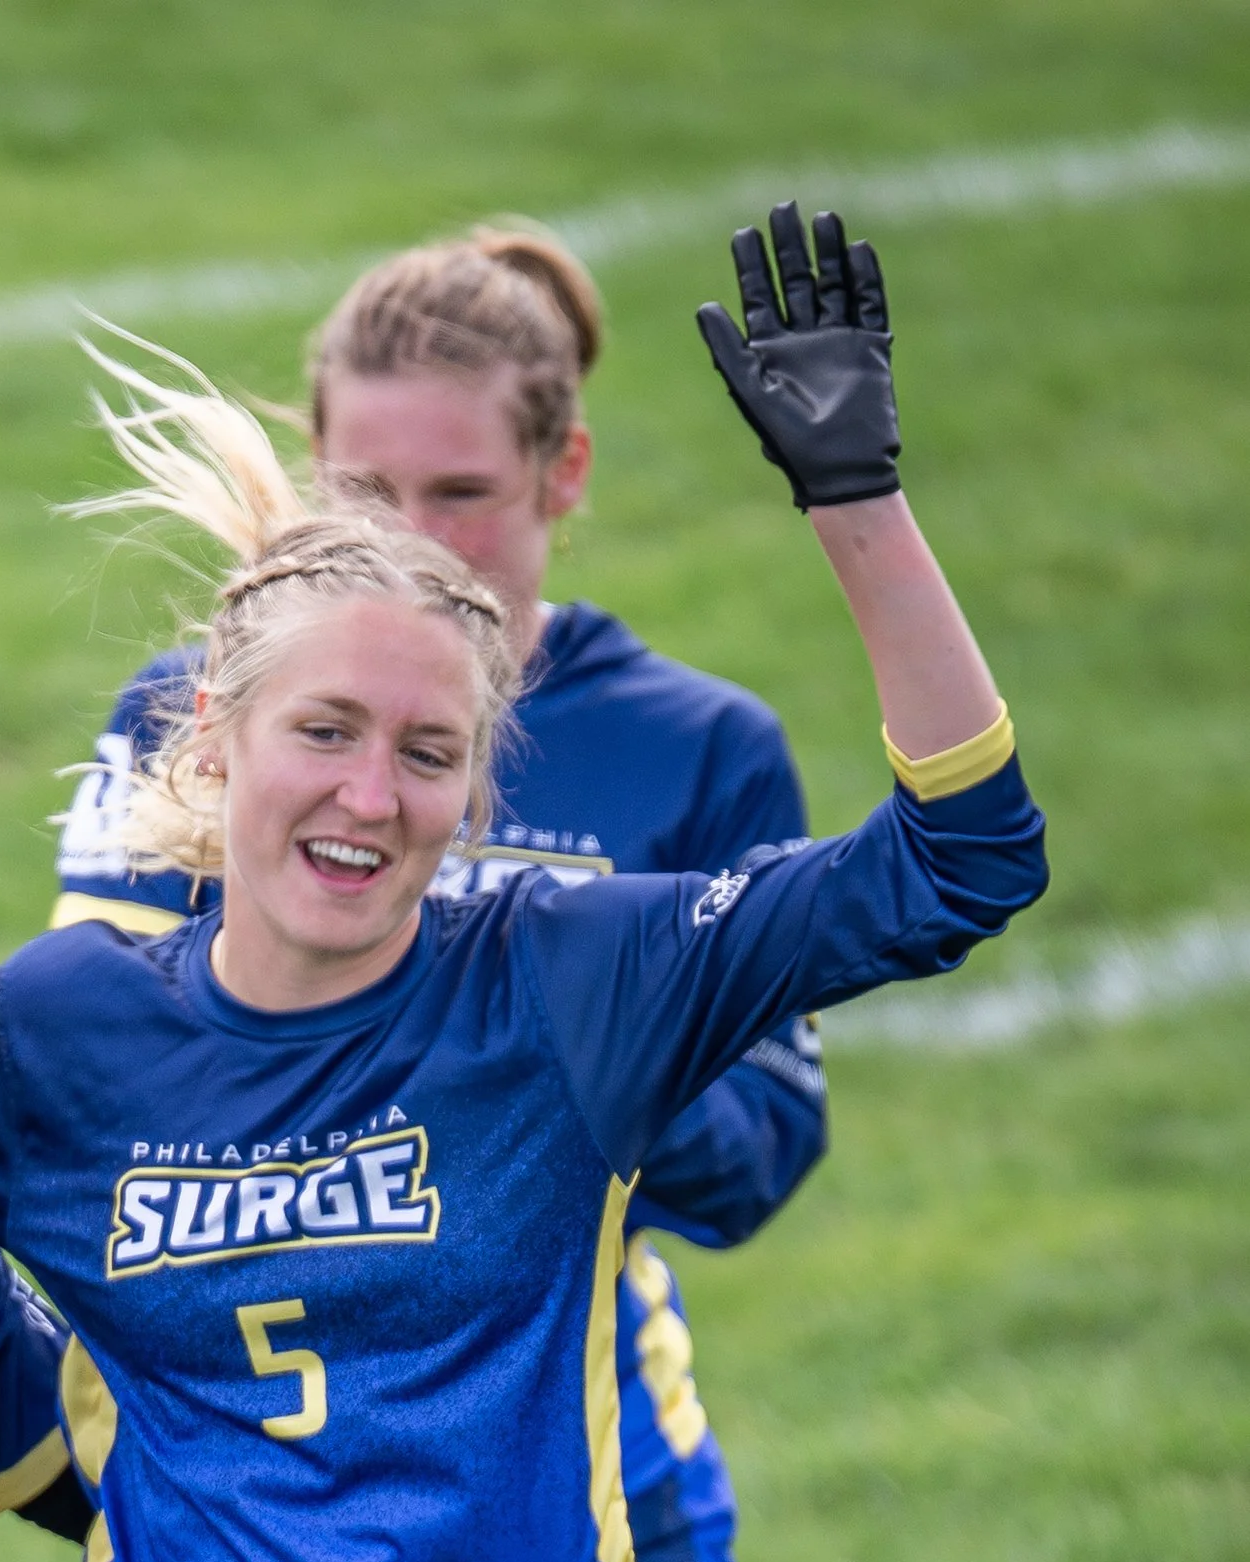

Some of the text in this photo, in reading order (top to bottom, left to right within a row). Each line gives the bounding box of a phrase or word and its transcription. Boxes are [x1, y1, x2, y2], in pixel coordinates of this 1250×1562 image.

[132, 1103, 408, 1165] PHILADELPIA
[115, 1141, 427, 1263] SURGE
[236, 1298, 328, 1440] 5
